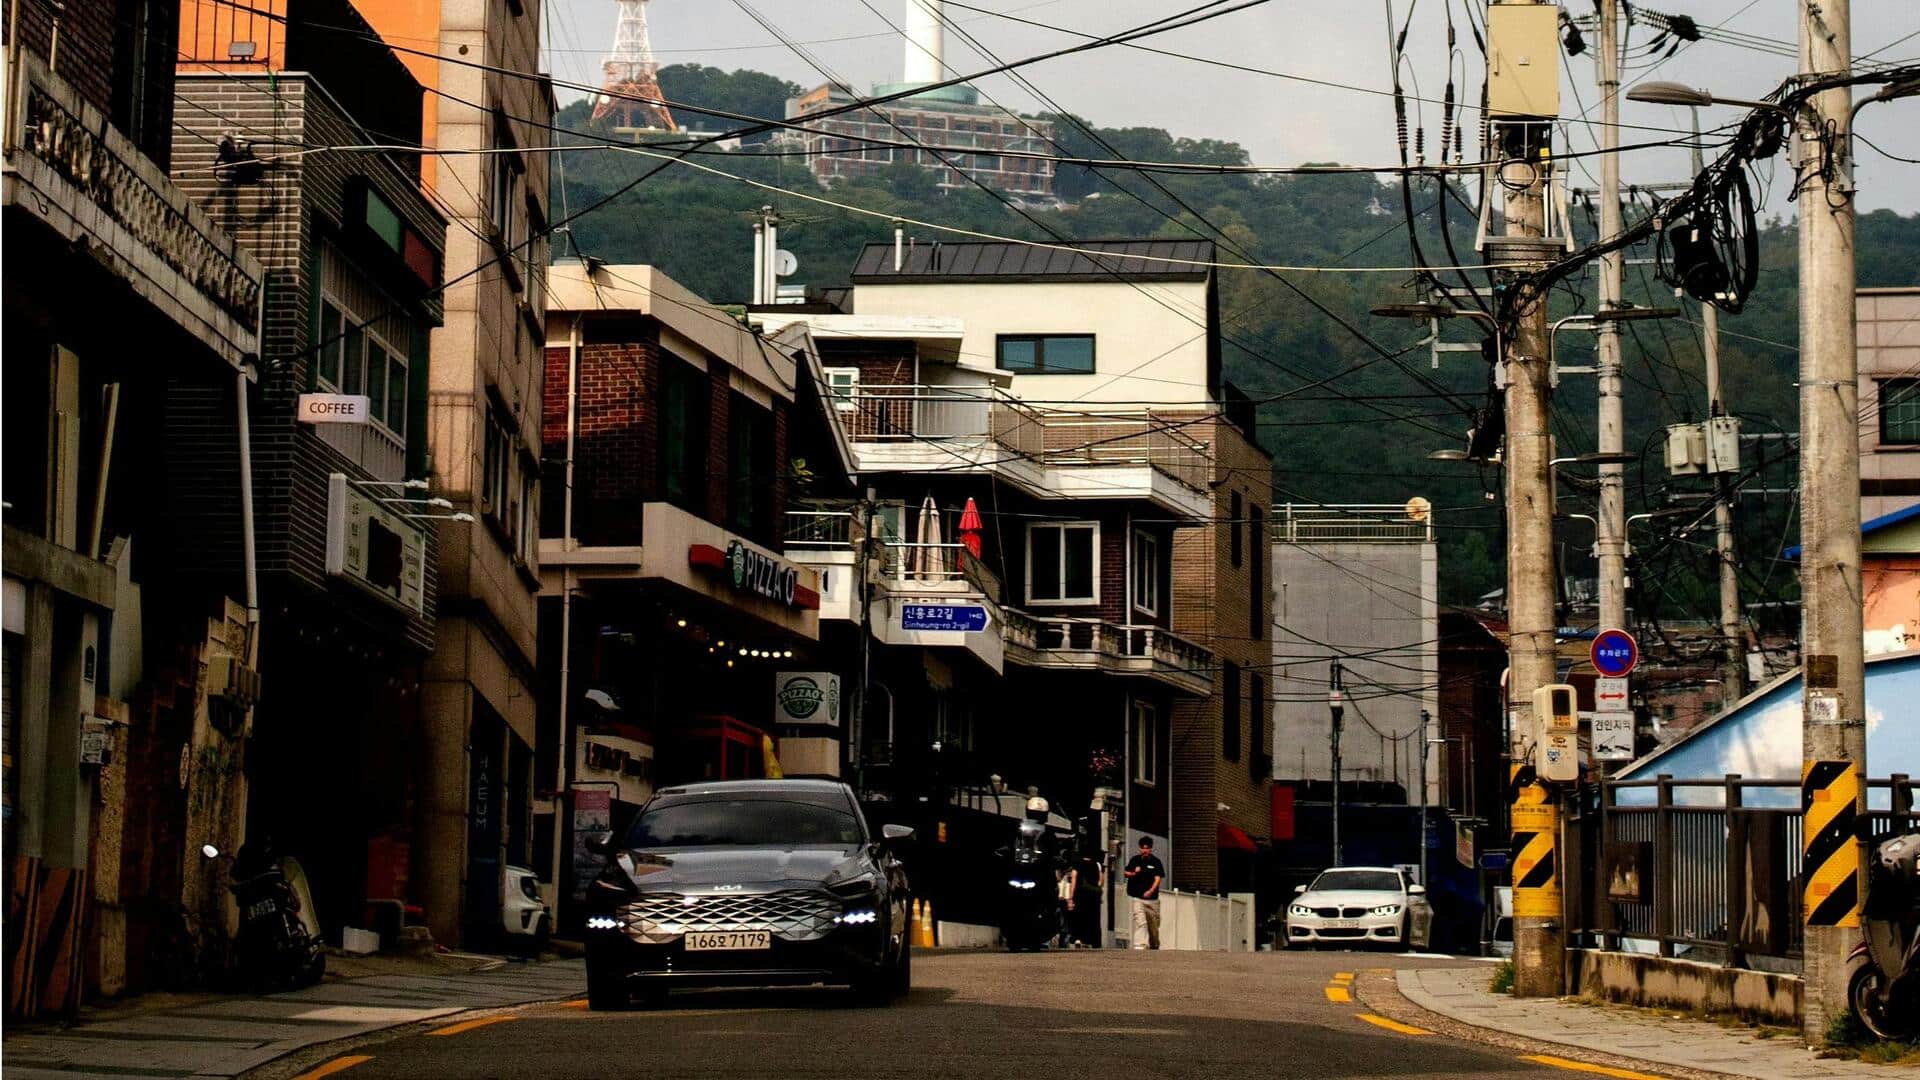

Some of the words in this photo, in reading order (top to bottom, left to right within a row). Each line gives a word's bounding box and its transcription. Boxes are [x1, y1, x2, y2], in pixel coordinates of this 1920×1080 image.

[309, 402, 355, 415] COFFEE
[745, 549, 782, 600] PIZZA
[905, 607, 954, 620] 신흥로2길
[903, 620, 951, 630] Sinheung-ro
